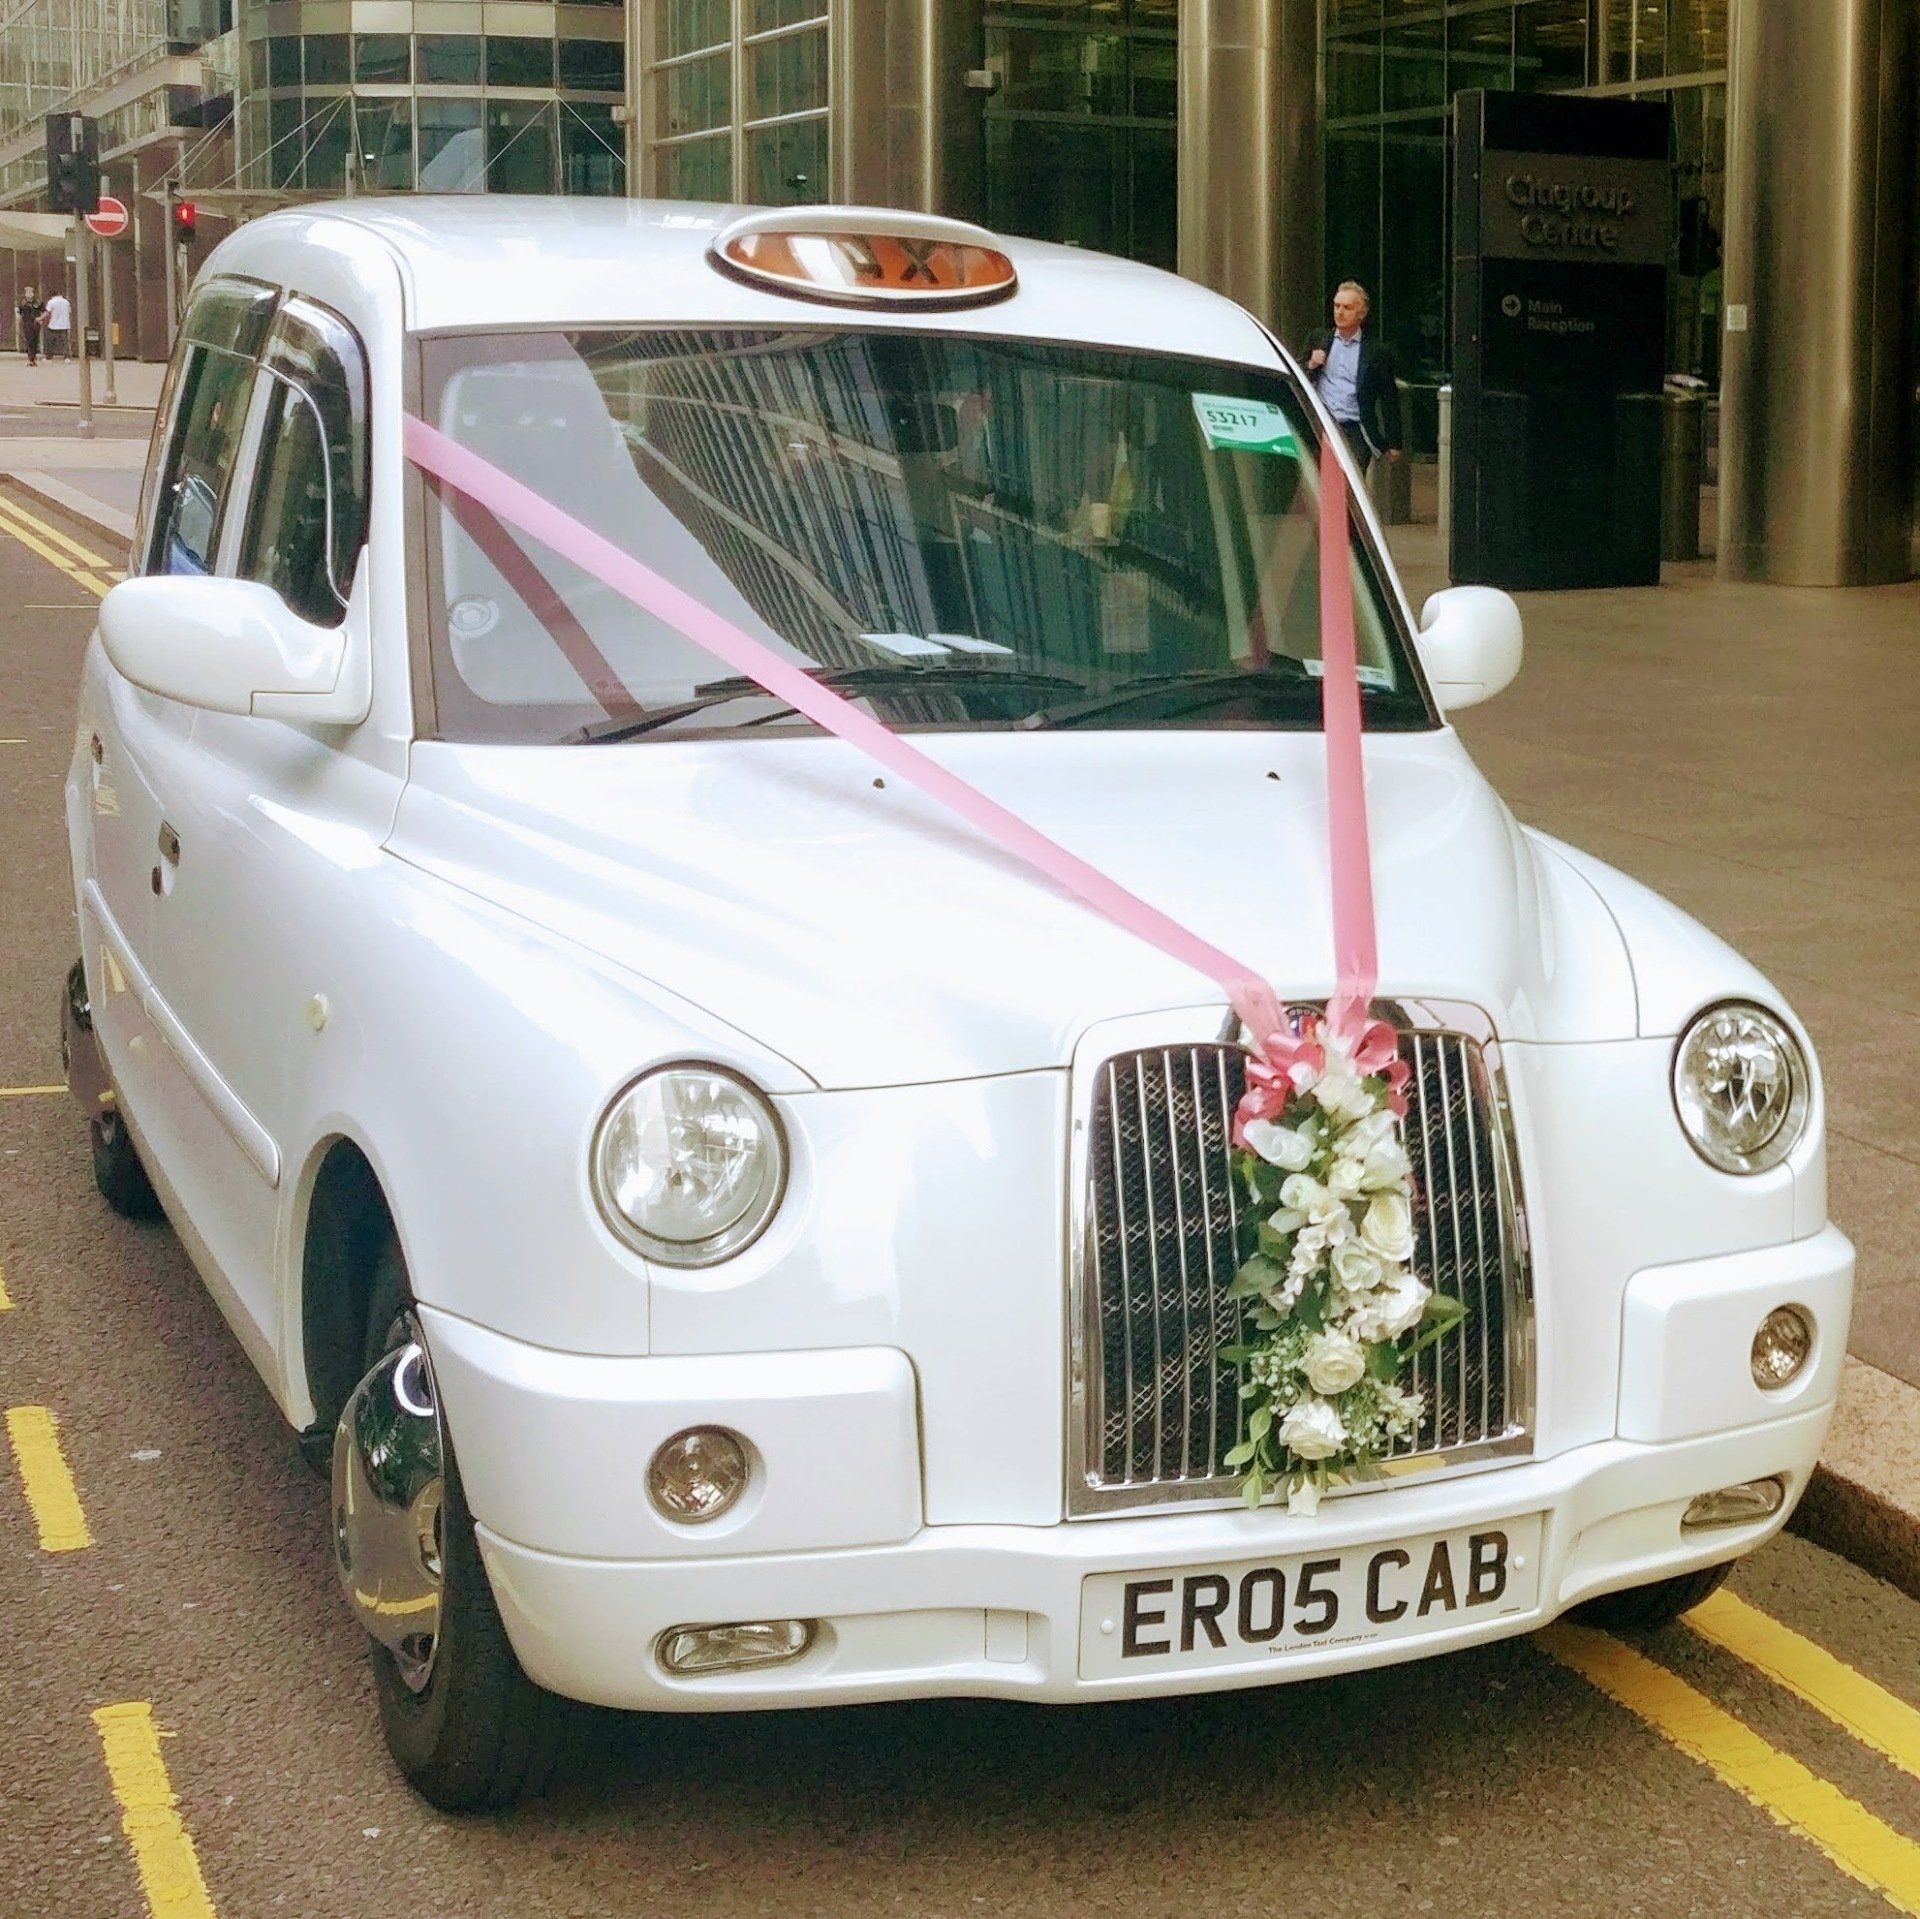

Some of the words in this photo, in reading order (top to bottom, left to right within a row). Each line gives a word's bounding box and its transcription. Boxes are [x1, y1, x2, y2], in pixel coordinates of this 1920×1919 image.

[1506, 174, 1635, 216] Citigroup
[1521, 215, 1616, 246] Centre
[1528, 299, 1562, 313] Main
[1528, 316, 1595, 333] Reception
[1206, 410, 1257, 427] 53217
[1367, 1530, 1509, 1625] CAB
